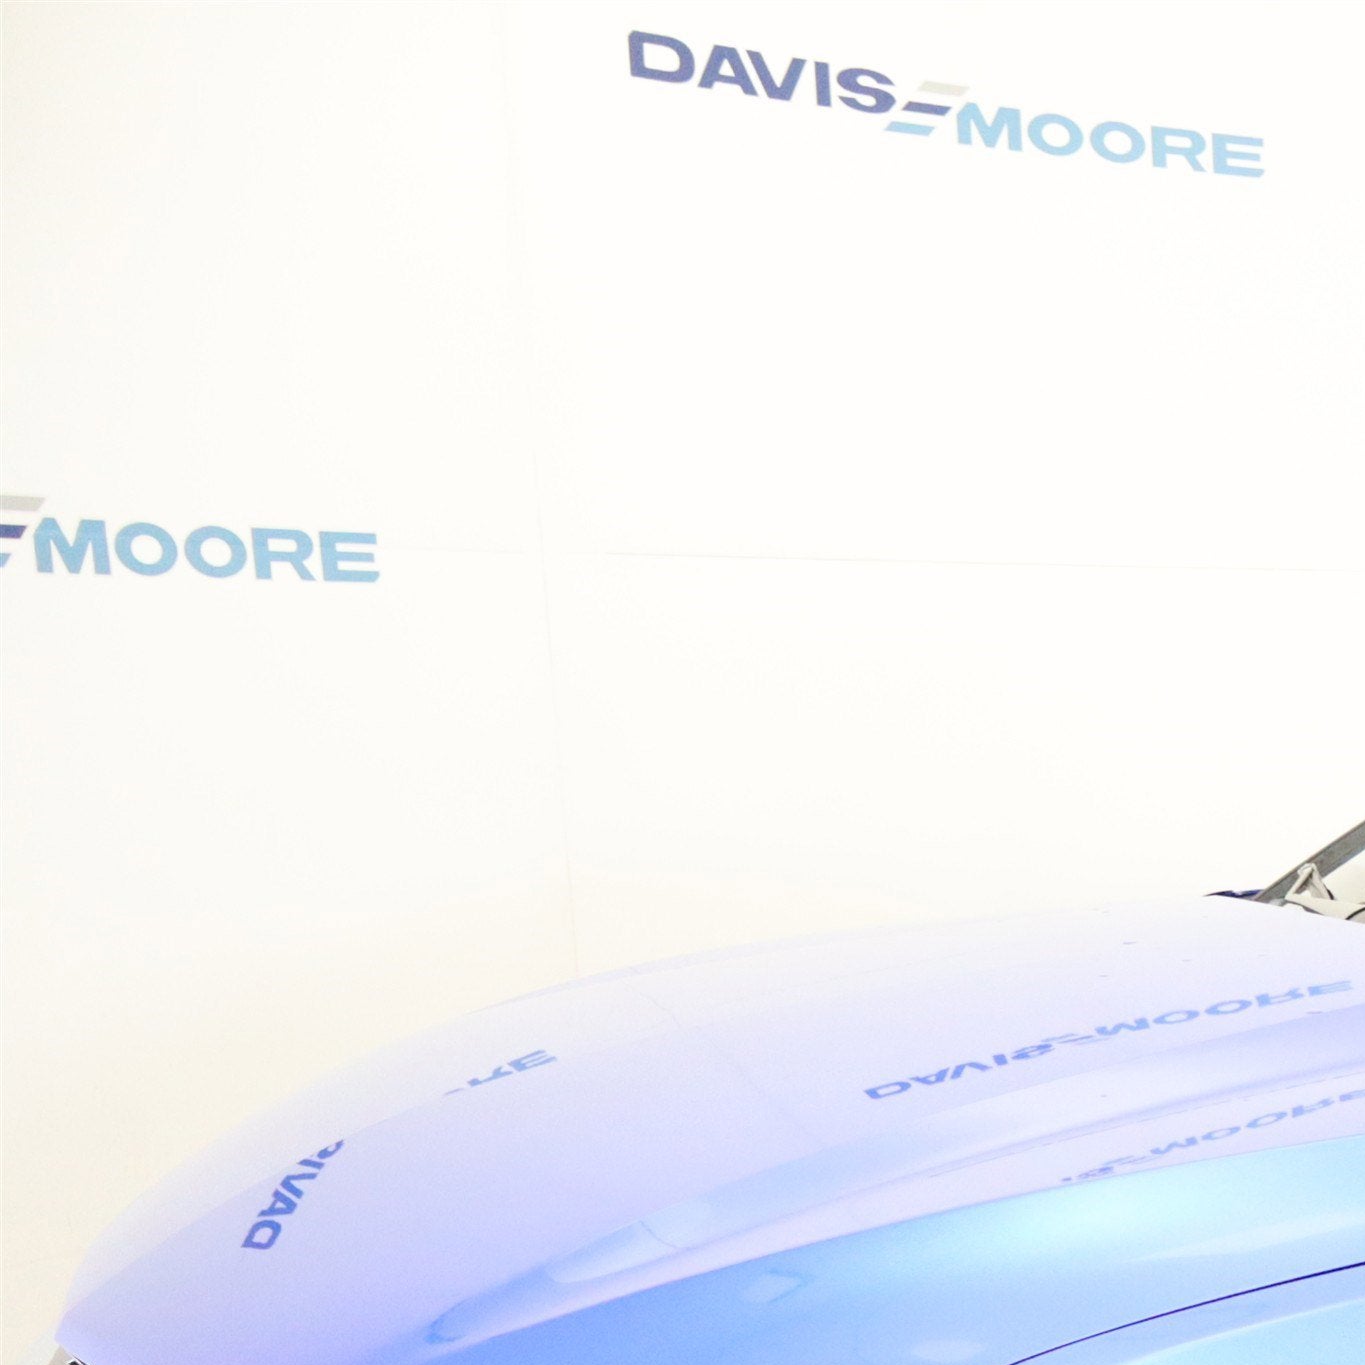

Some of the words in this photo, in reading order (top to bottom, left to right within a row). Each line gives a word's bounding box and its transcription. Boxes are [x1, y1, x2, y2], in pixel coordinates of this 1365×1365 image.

[628, 29, 896, 114] DAVIS
[955, 101, 1264, 178] MOORE
[33, 517, 380, 583] MOORE
